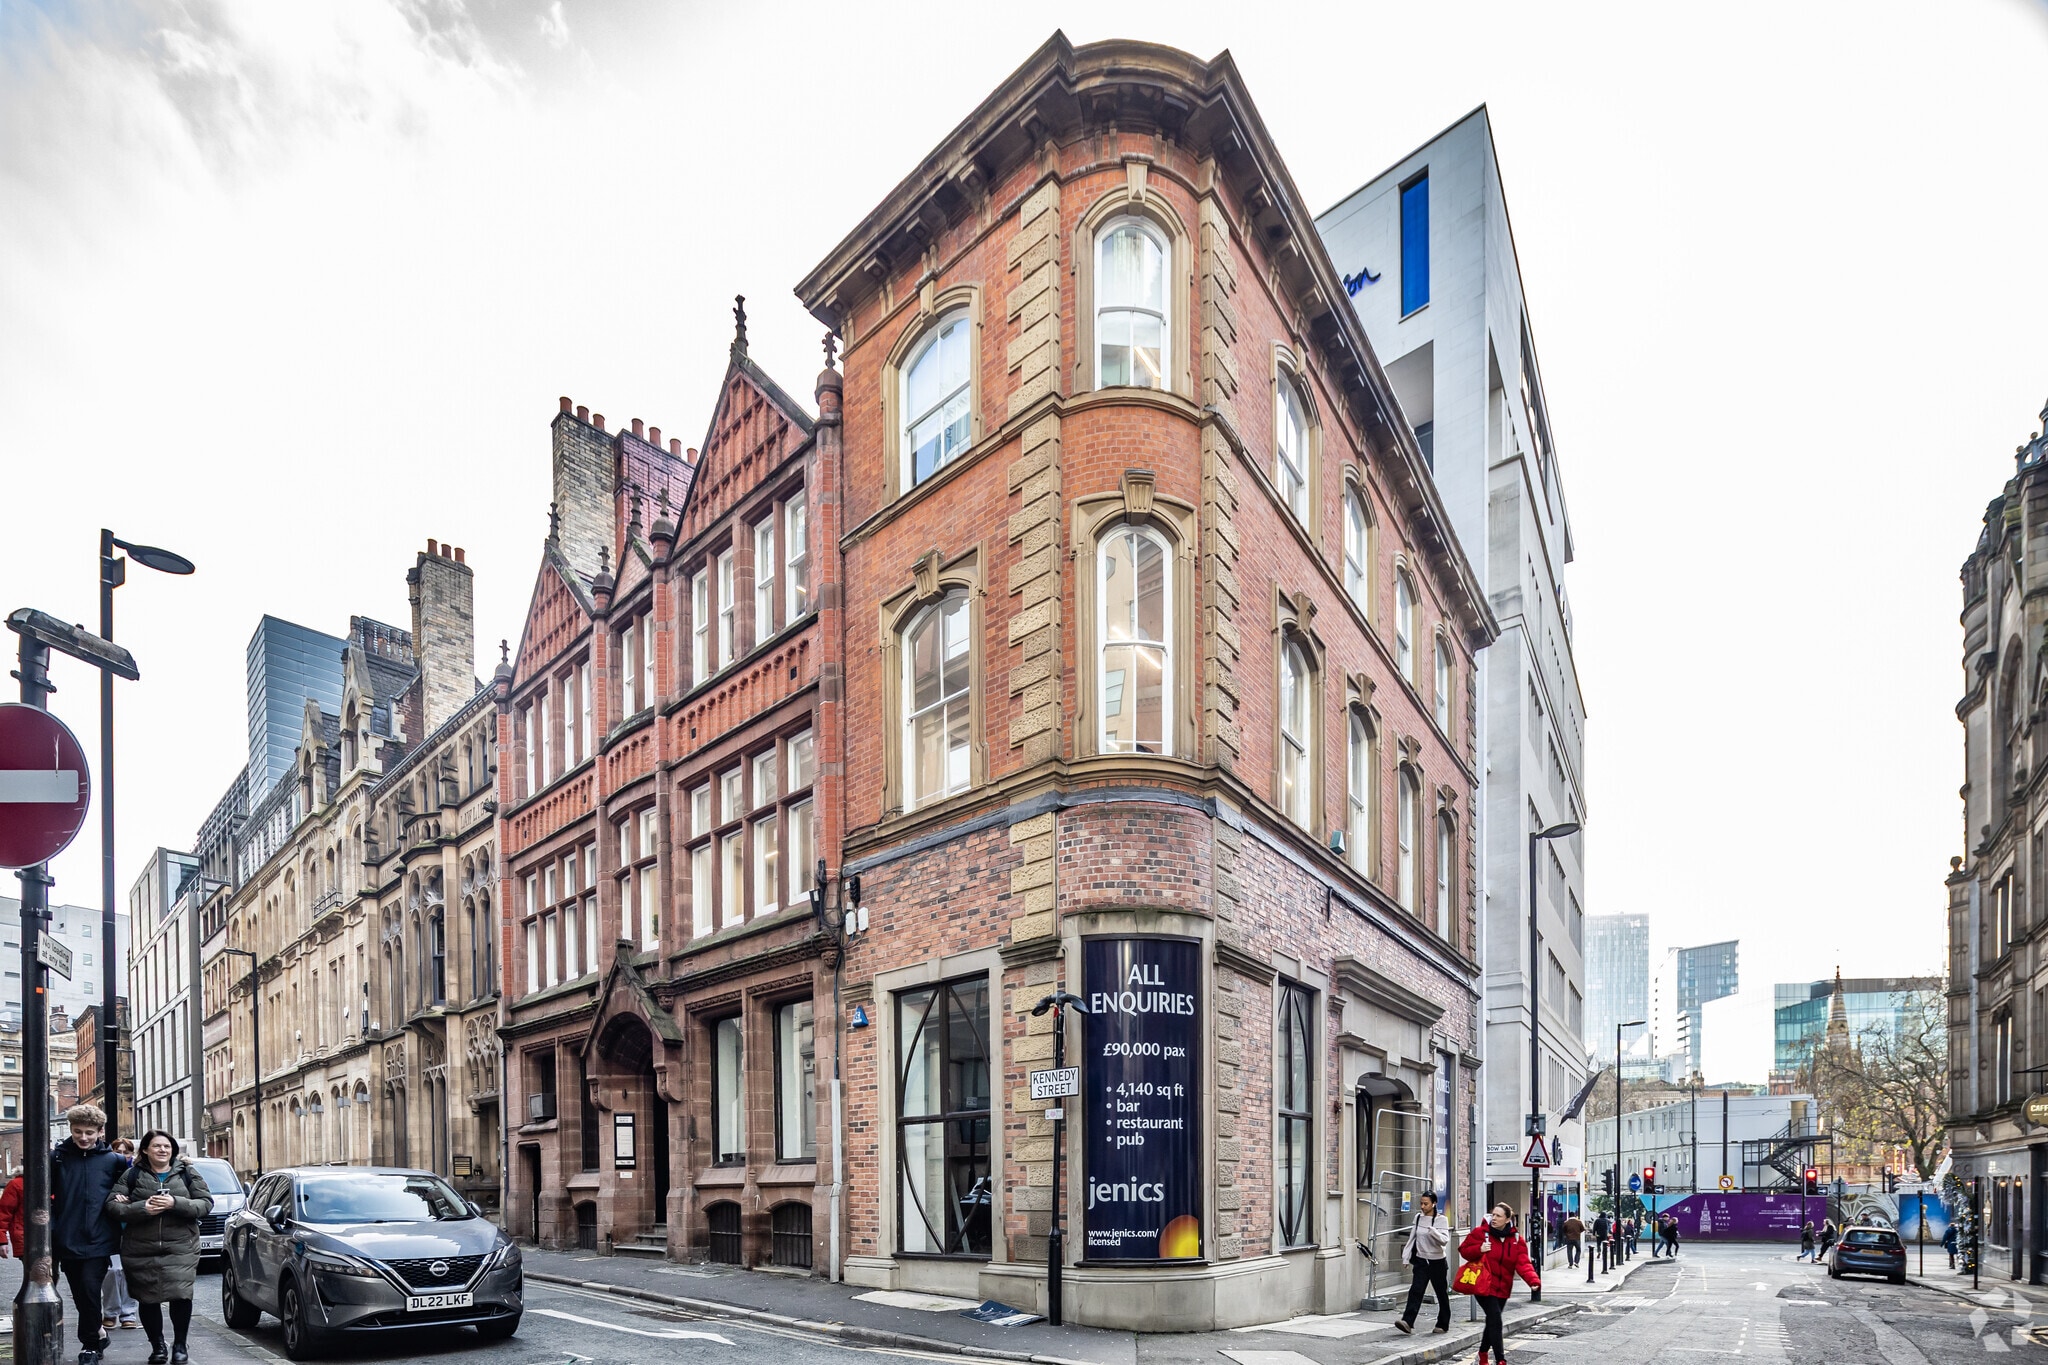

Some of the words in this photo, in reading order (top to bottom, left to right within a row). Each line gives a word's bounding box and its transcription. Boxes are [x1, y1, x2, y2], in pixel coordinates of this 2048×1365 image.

[42, 937, 51, 949] No
[52, 943, 69, 963] loading
[49, 955, 58, 966] any
[59, 960, 69, 972] time
[1127, 964, 1165, 986] ALL
[1091, 991, 1195, 1017] ENQUIRIES
[1103, 1042, 1160, 1058] £90,000
[1163, 1045, 1185, 1060] pax
[1033, 1069, 1077, 1085] KENNEDY
[1037, 1082, 1072, 1097] STREET
[1116, 1082, 1153, 1098] 4,140
[1156, 1085, 1171, 1100] sq
[1174, 1082, 1184, 1097] ft
[1116, 1099, 1140, 1112] bar
[1116, 1117, 1184, 1129] restaurant
[1116, 1132, 1145, 1150] pub
[1088, 1176, 1165, 1210] jenics
[1088, 1228, 1160, 1239] www.jenics.com/
[1088, 1237, 1121, 1246] licensed
[412, 1296, 443, 1308] DL22
[446, 1294, 468, 1306] LKF
